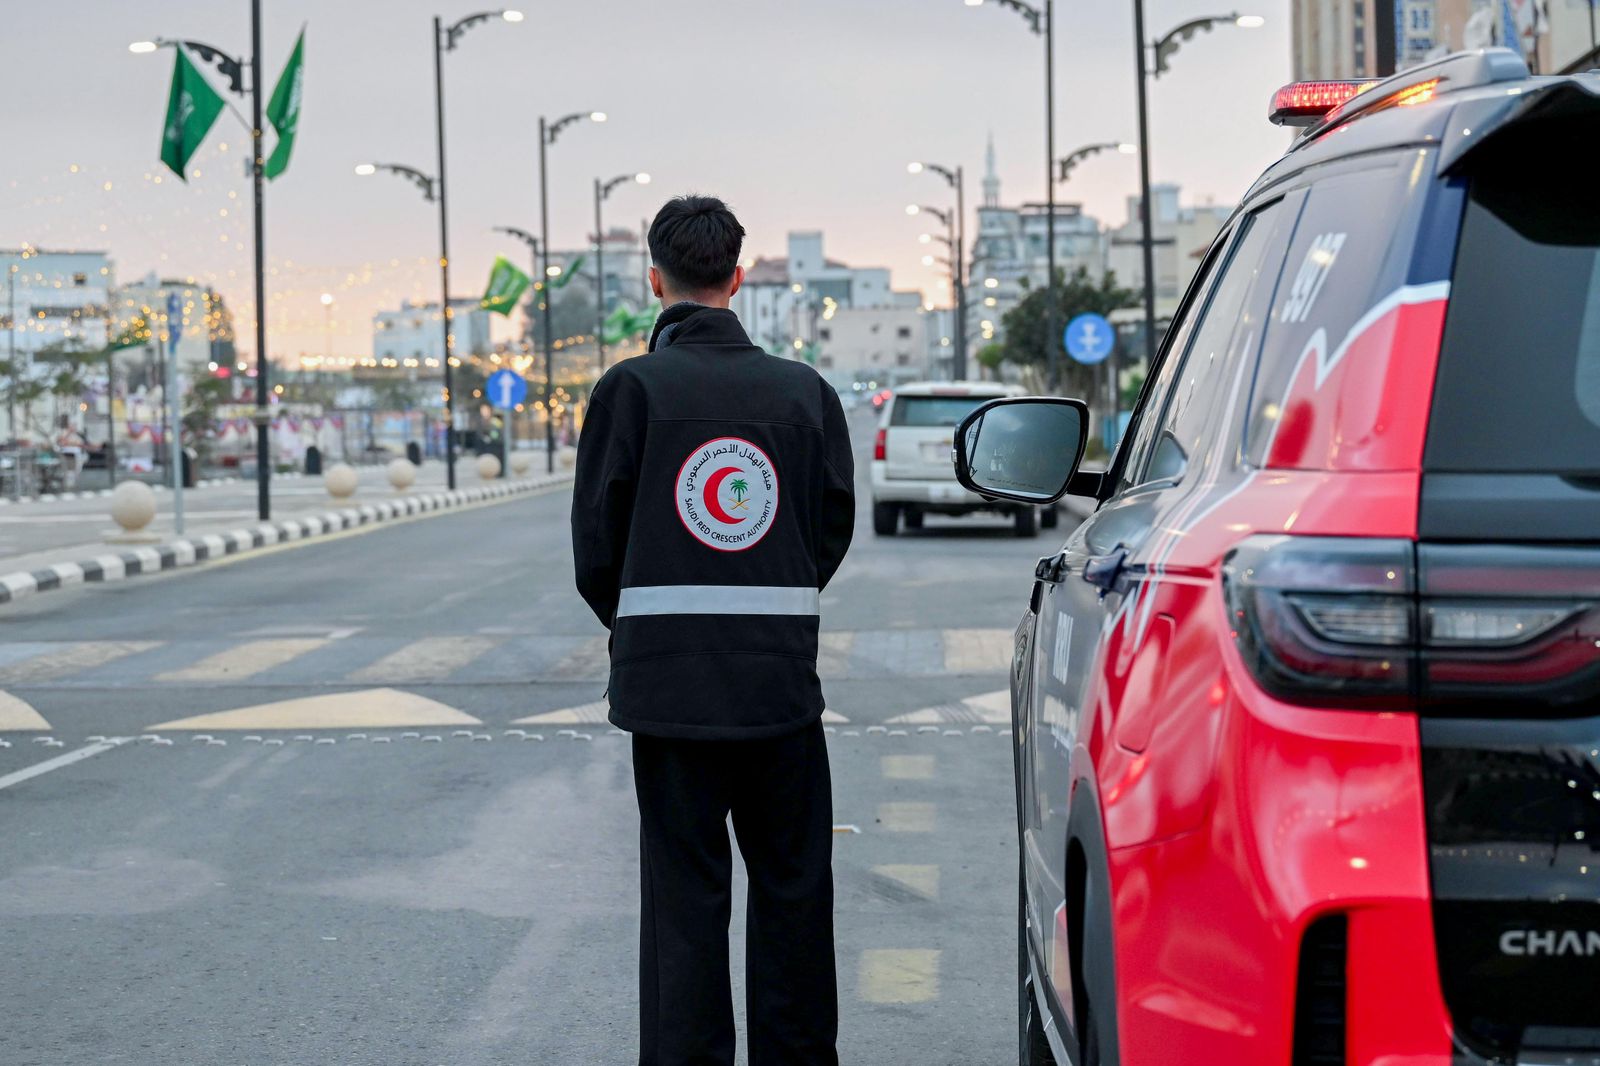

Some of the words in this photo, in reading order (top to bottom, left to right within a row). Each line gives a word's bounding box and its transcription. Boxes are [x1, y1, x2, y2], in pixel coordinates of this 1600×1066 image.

[1281, 232, 1346, 323] 997
[713, 444, 738, 459] الأحمر
[739, 448, 765, 469] الهلال
[687, 450, 712, 492] السعودي
[762, 469, 771, 491] هيئة
[685, 497, 700, 523] SAUDI
[696, 520, 711, 535] RED
[711, 531, 746, 543] CRESCENT
[747, 499, 772, 538] AUTHORITY
